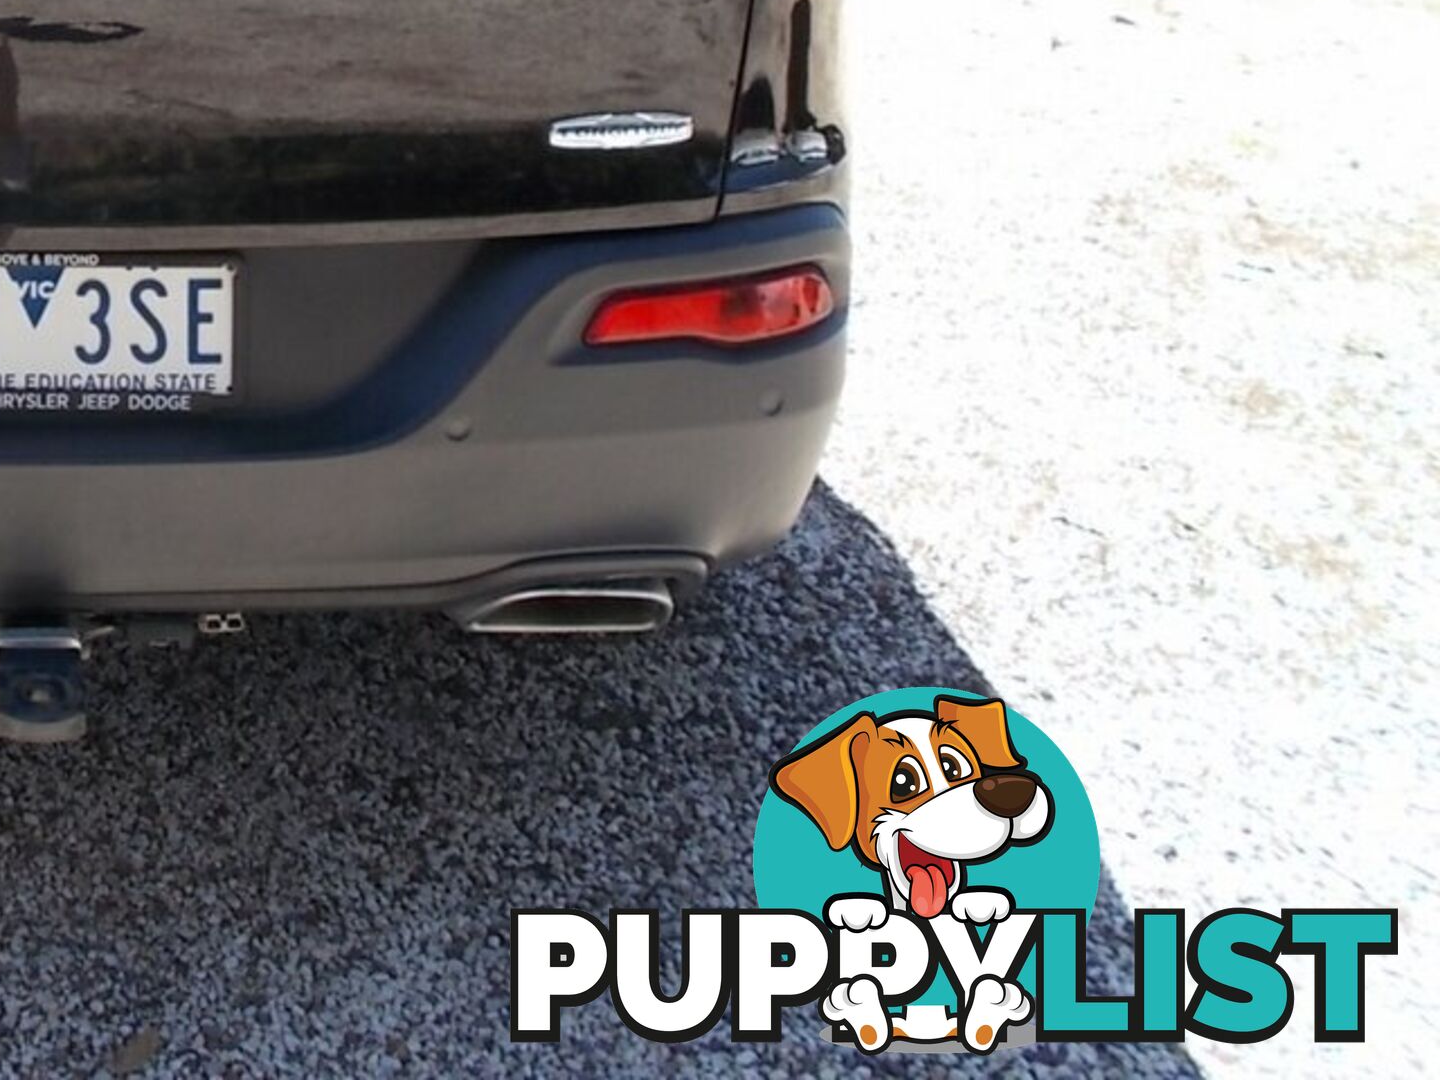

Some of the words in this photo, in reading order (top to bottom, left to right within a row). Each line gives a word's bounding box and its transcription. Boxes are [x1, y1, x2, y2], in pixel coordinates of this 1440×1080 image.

[31, 254, 40, 265] &
[44, 254, 100, 266] BEYOND
[19, 280, 55, 299] VIC
[74, 279, 223, 365] 3SE
[24, 373, 146, 391] EDUCATION
[154, 373, 216, 391] STATE
[78, 394, 120, 410] JEEP
[127, 394, 192, 411] DODGE
